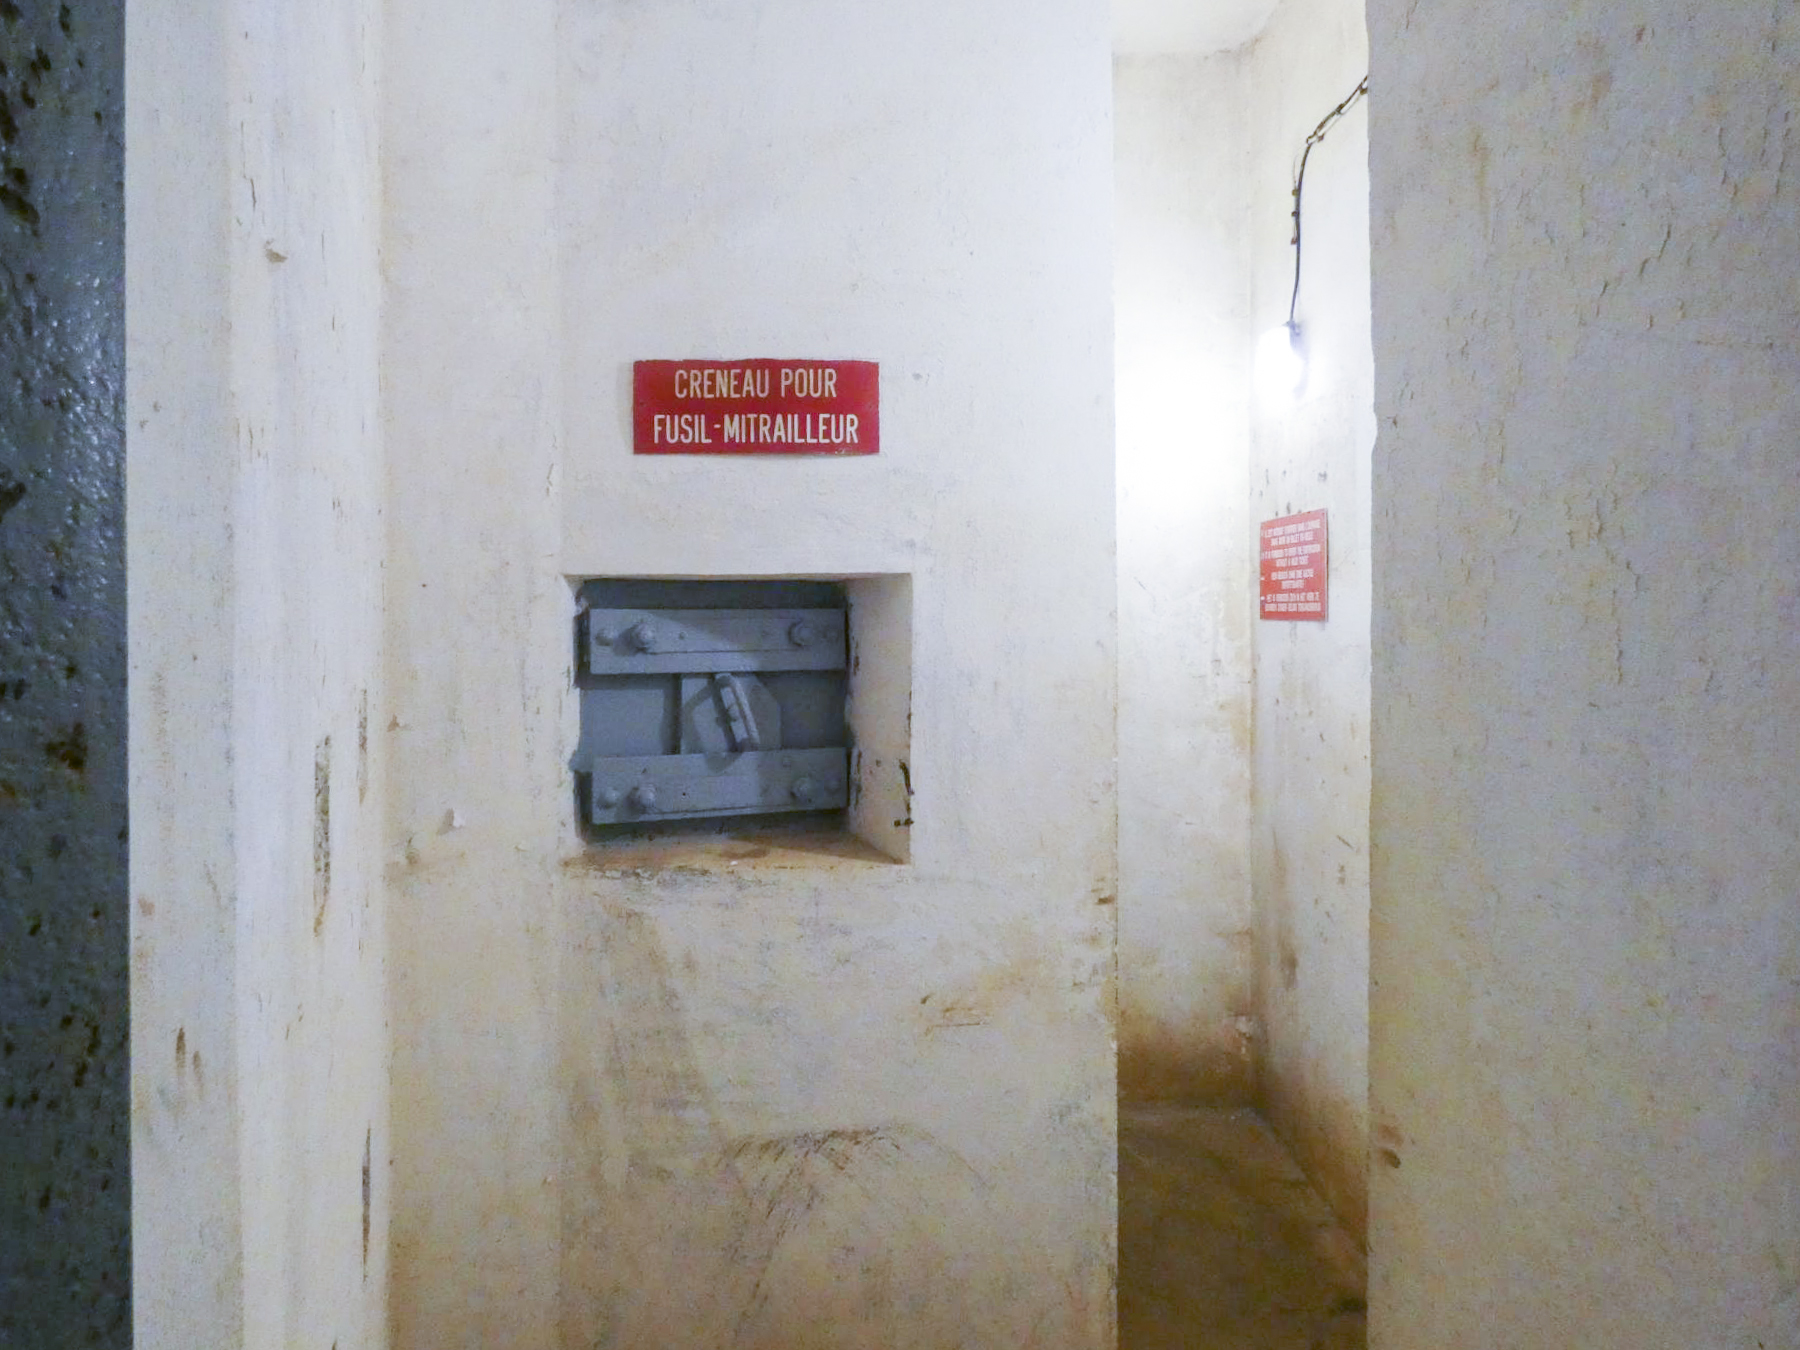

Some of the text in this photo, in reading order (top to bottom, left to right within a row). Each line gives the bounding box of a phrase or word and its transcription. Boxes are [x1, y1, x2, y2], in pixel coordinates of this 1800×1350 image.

[674, 368, 837, 398] CRENEAU POUR
[653, 414, 858, 443] FUSIL-MITRAILLEUR
